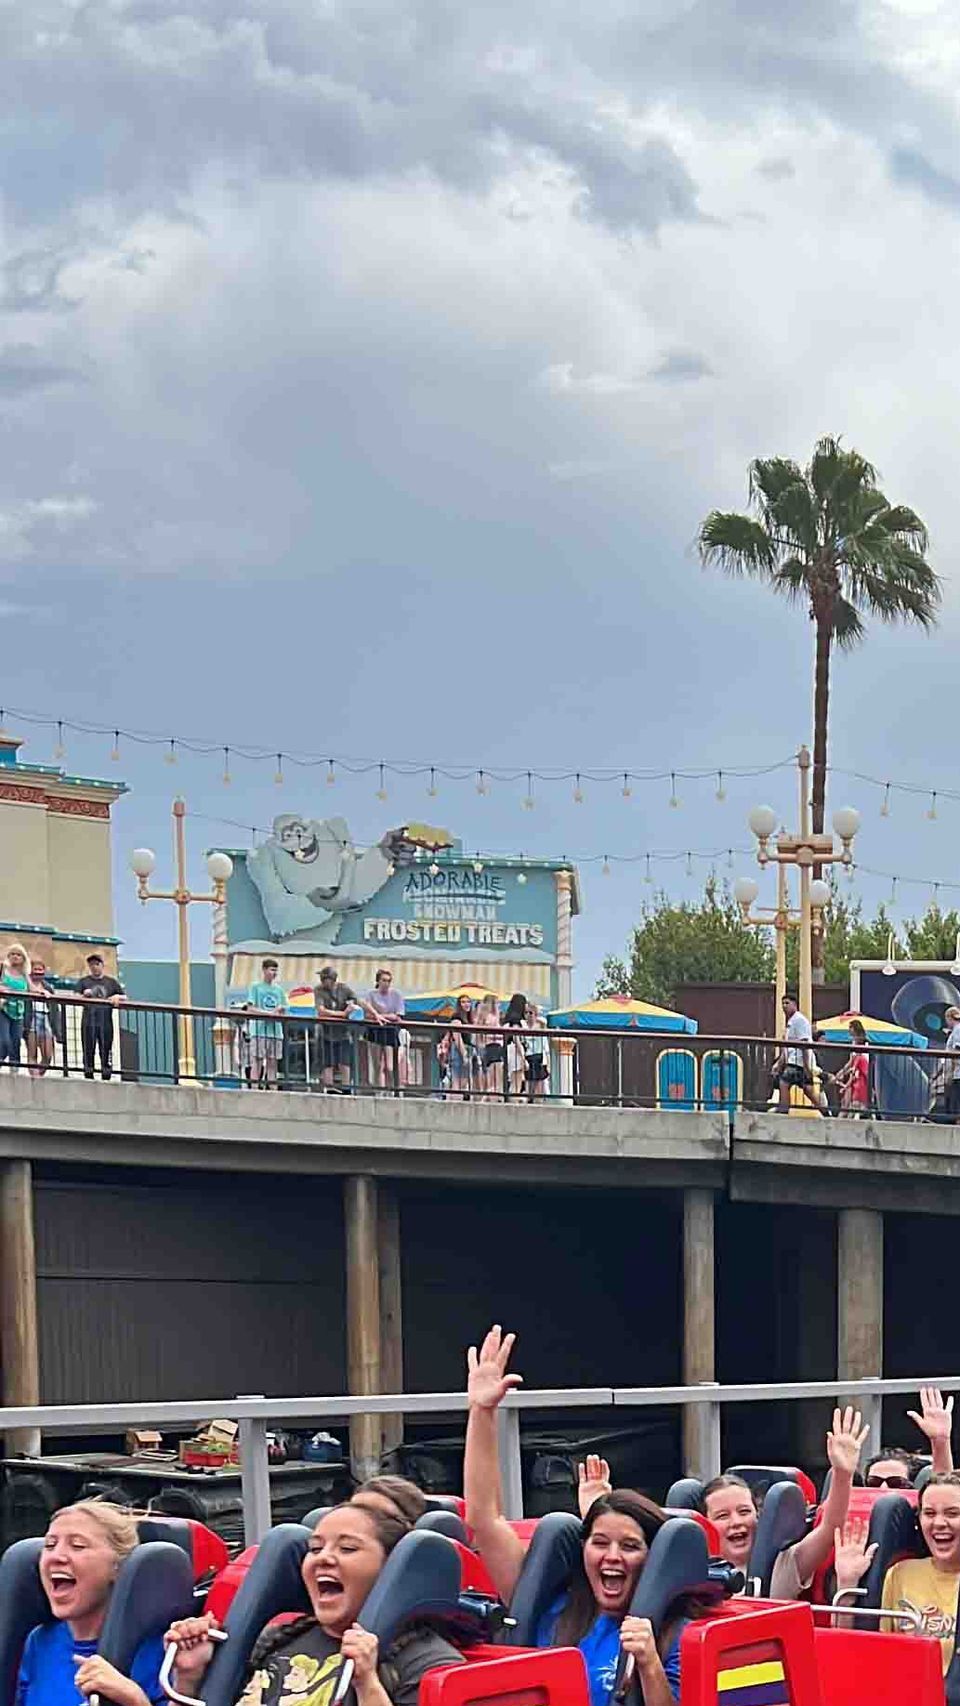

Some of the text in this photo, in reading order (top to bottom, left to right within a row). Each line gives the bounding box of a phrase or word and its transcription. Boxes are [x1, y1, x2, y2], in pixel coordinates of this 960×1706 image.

[404, 871, 506, 892] ADORABLE
[363, 918, 544, 945] FROSTED TREATS
